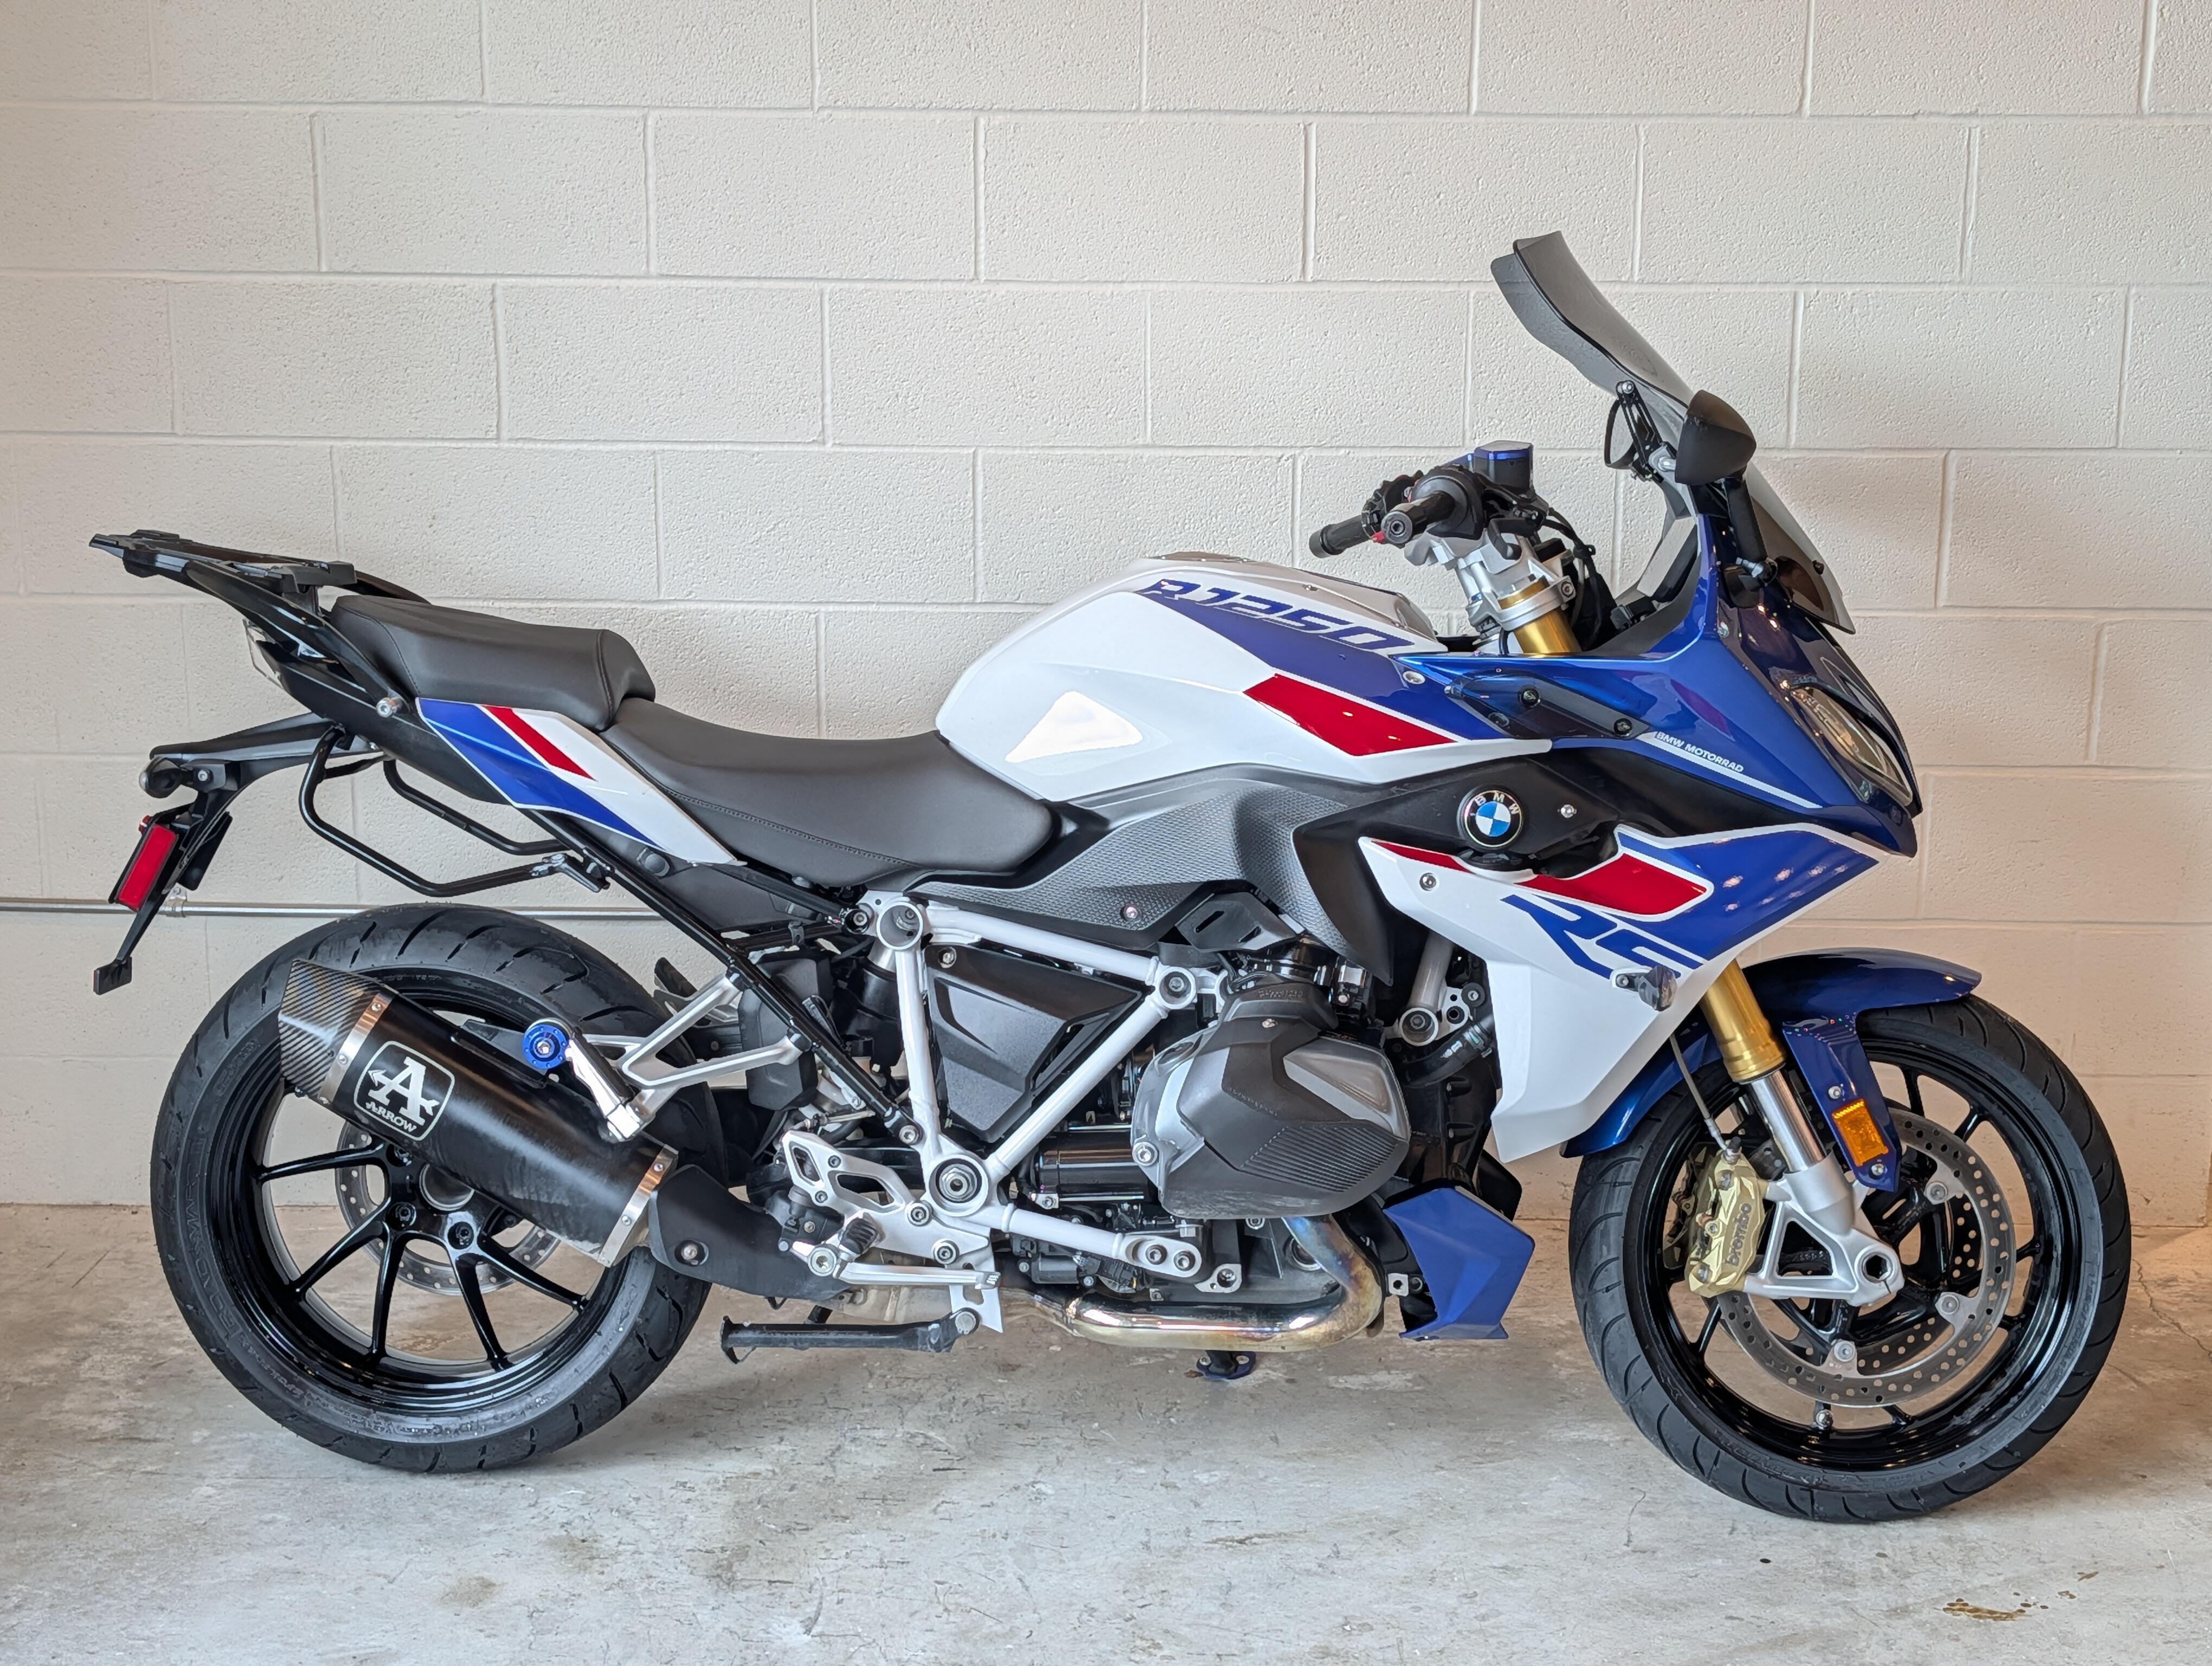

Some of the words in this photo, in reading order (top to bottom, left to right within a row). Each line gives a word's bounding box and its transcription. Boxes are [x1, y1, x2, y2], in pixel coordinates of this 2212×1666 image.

[1656, 731, 1685, 748] BMW
[1684, 743, 1745, 773] MOTORRAD
[1474, 792, 1520, 815] BMW
[365, 1101, 417, 1132] ARROW
[1724, 1202, 1753, 1267] brembo
